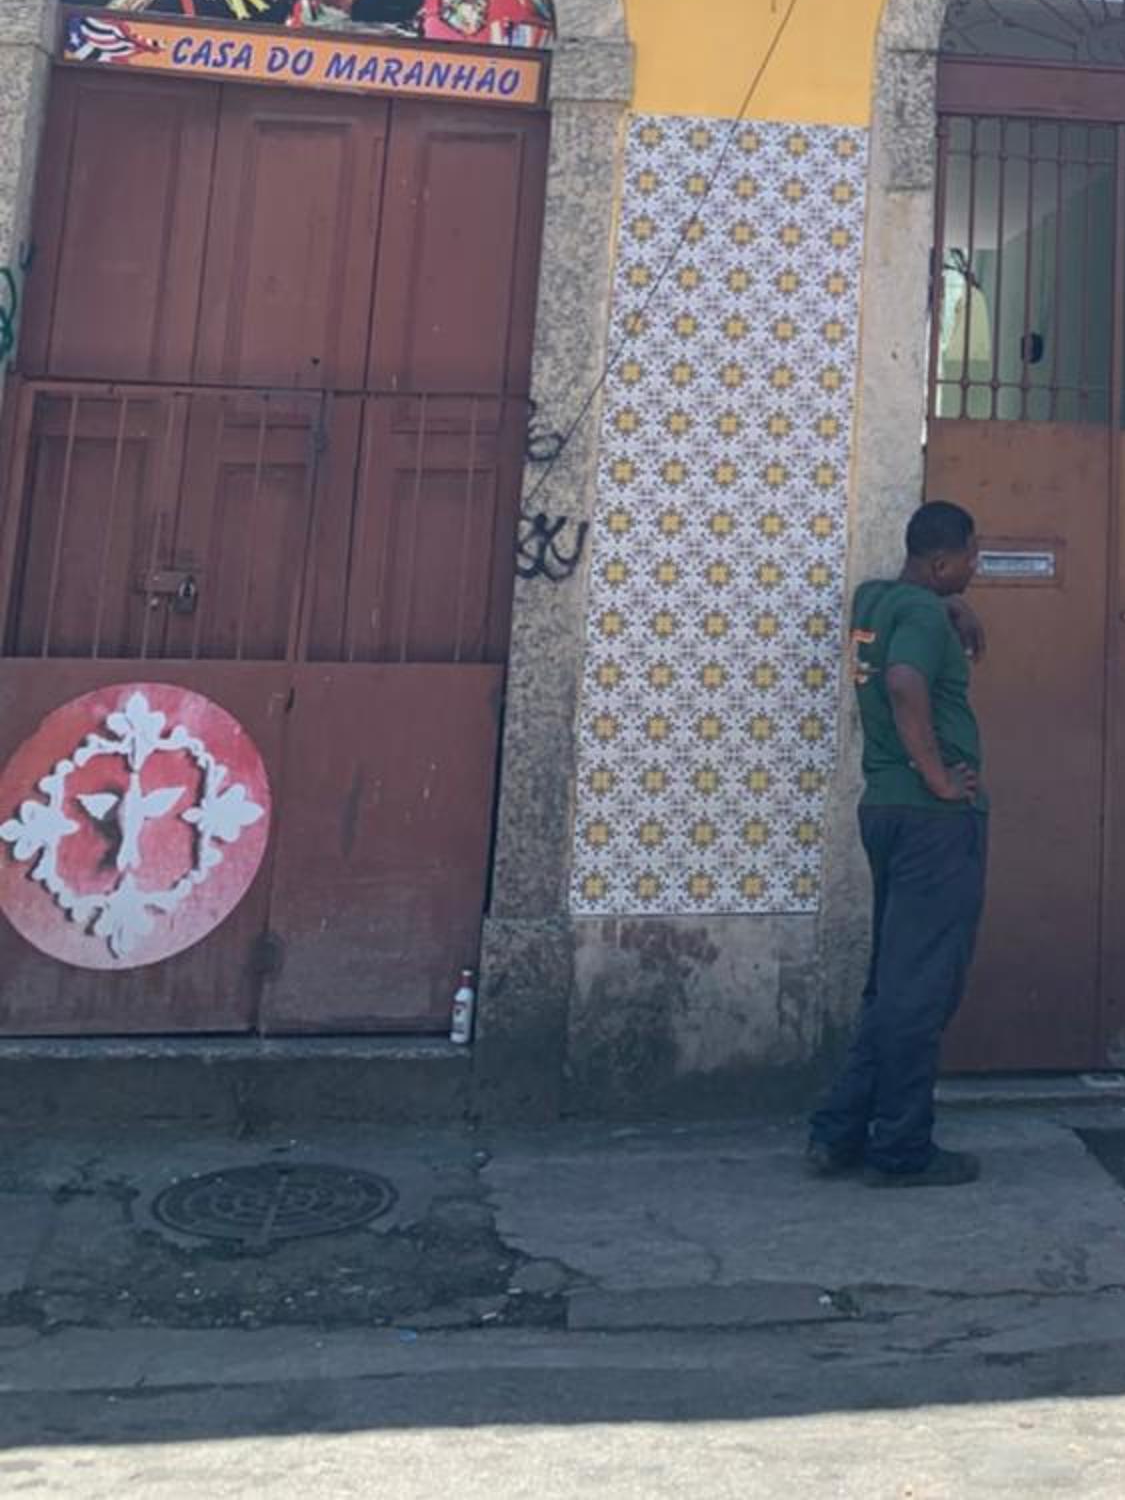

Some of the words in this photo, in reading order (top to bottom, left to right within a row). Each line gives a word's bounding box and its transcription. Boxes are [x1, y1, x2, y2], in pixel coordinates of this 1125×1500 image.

[170, 35, 254, 72] CASA
[265, 44, 315, 76] DO
[324, 54, 522, 96] MARANHÃO
